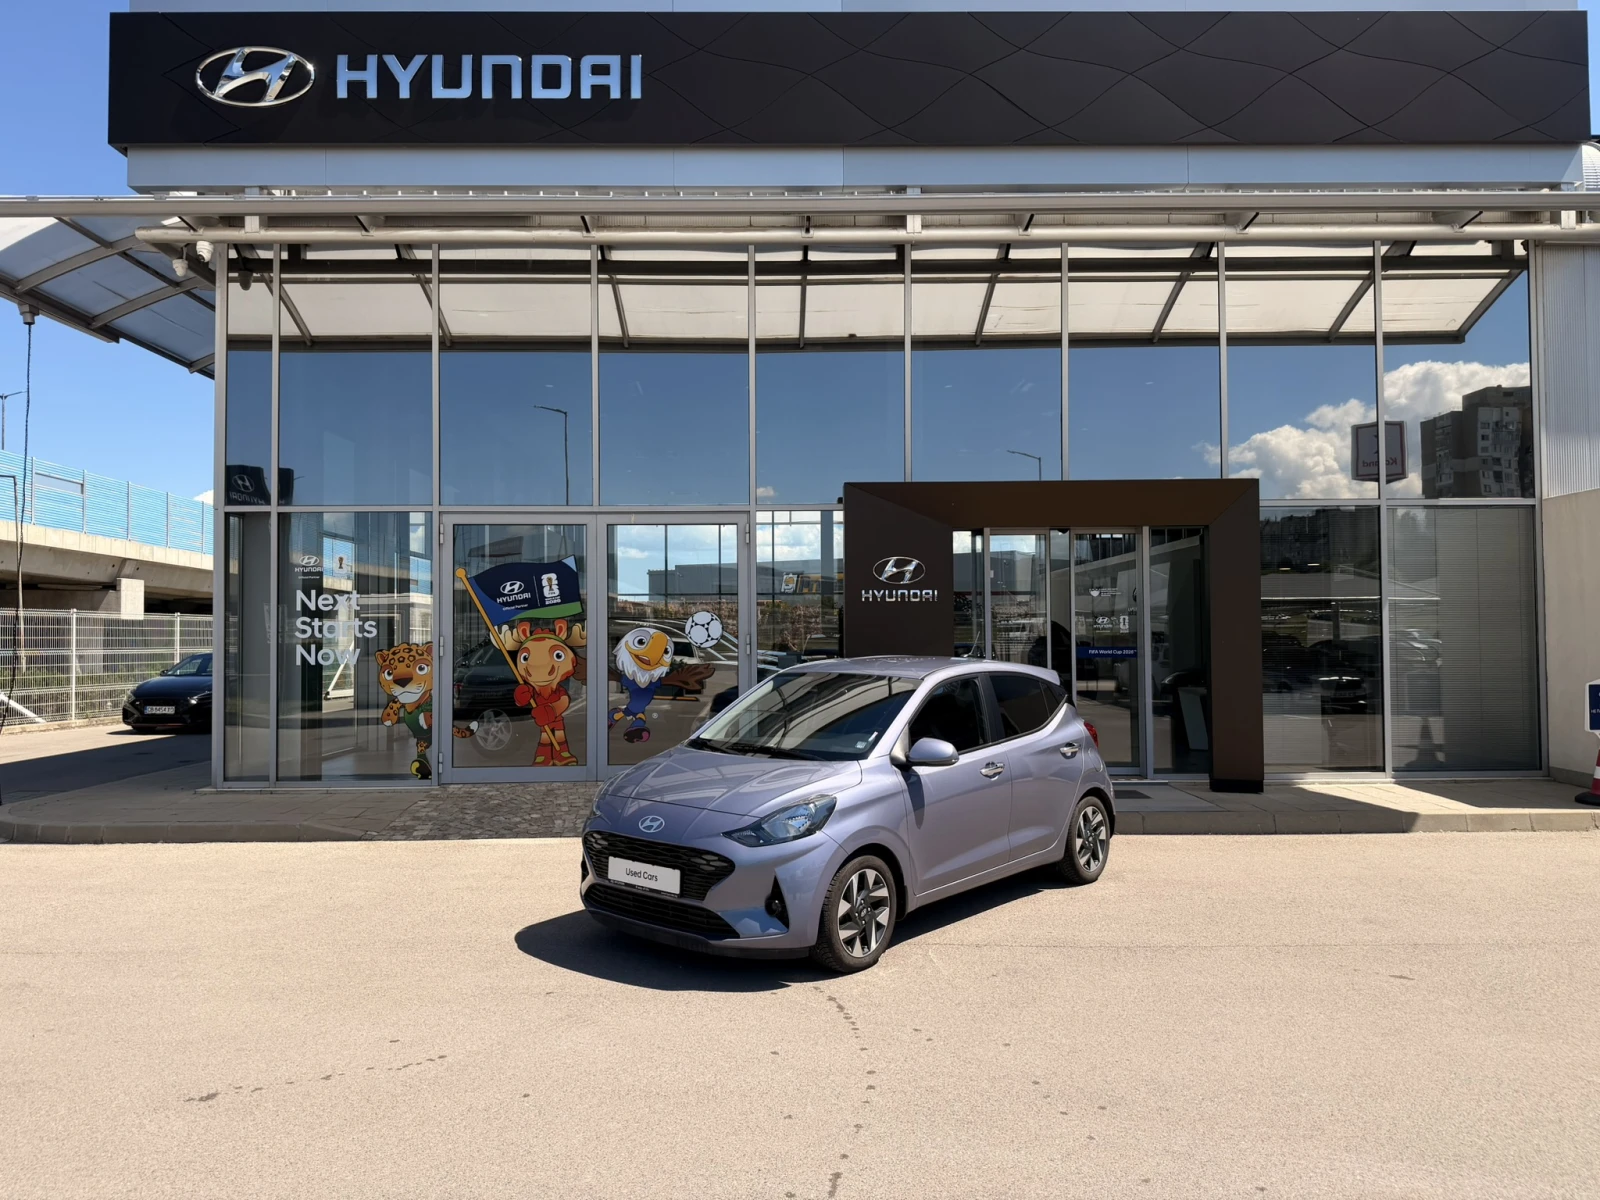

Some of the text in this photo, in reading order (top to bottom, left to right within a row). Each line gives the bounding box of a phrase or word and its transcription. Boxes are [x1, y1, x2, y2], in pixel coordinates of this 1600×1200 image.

[336, 54, 642, 99] HYUNDAI
[296, 589, 360, 612] Next
[497, 593, 531, 603] HYUNDAI
[861, 589, 938, 602] HYUNDAI
[294, 617, 377, 638] Starts
[296, 644, 361, 666] Now
[625, 867, 658, 882] Used Cars
